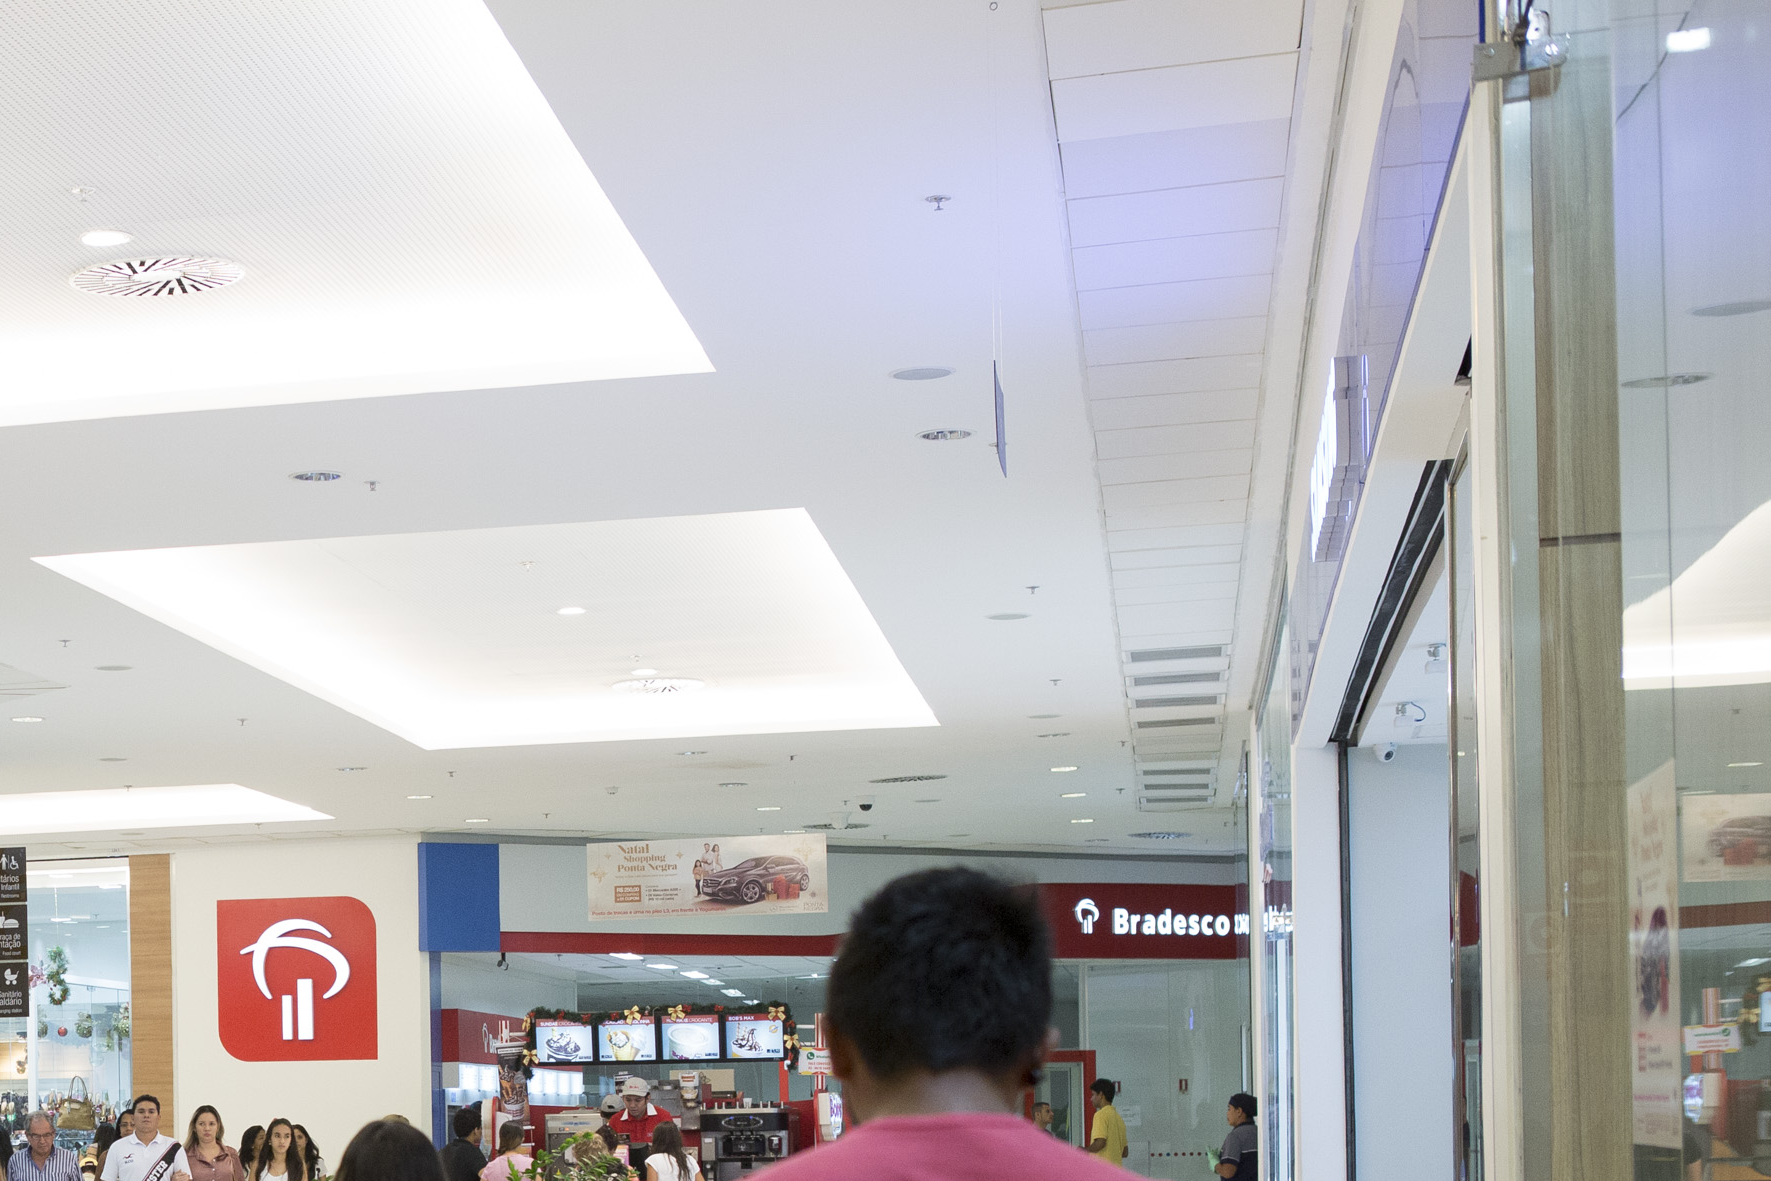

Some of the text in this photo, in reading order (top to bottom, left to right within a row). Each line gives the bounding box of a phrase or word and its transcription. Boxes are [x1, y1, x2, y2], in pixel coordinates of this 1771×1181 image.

[617, 843, 649, 855] Natal
[623, 854, 666, 864] Shopping
[617, 863, 677, 873] Ponta Negra
[1, 883, 20, 891] Infantil
[1113, 907, 1231, 936] Bradesco
[13, 933, 21, 941] de
